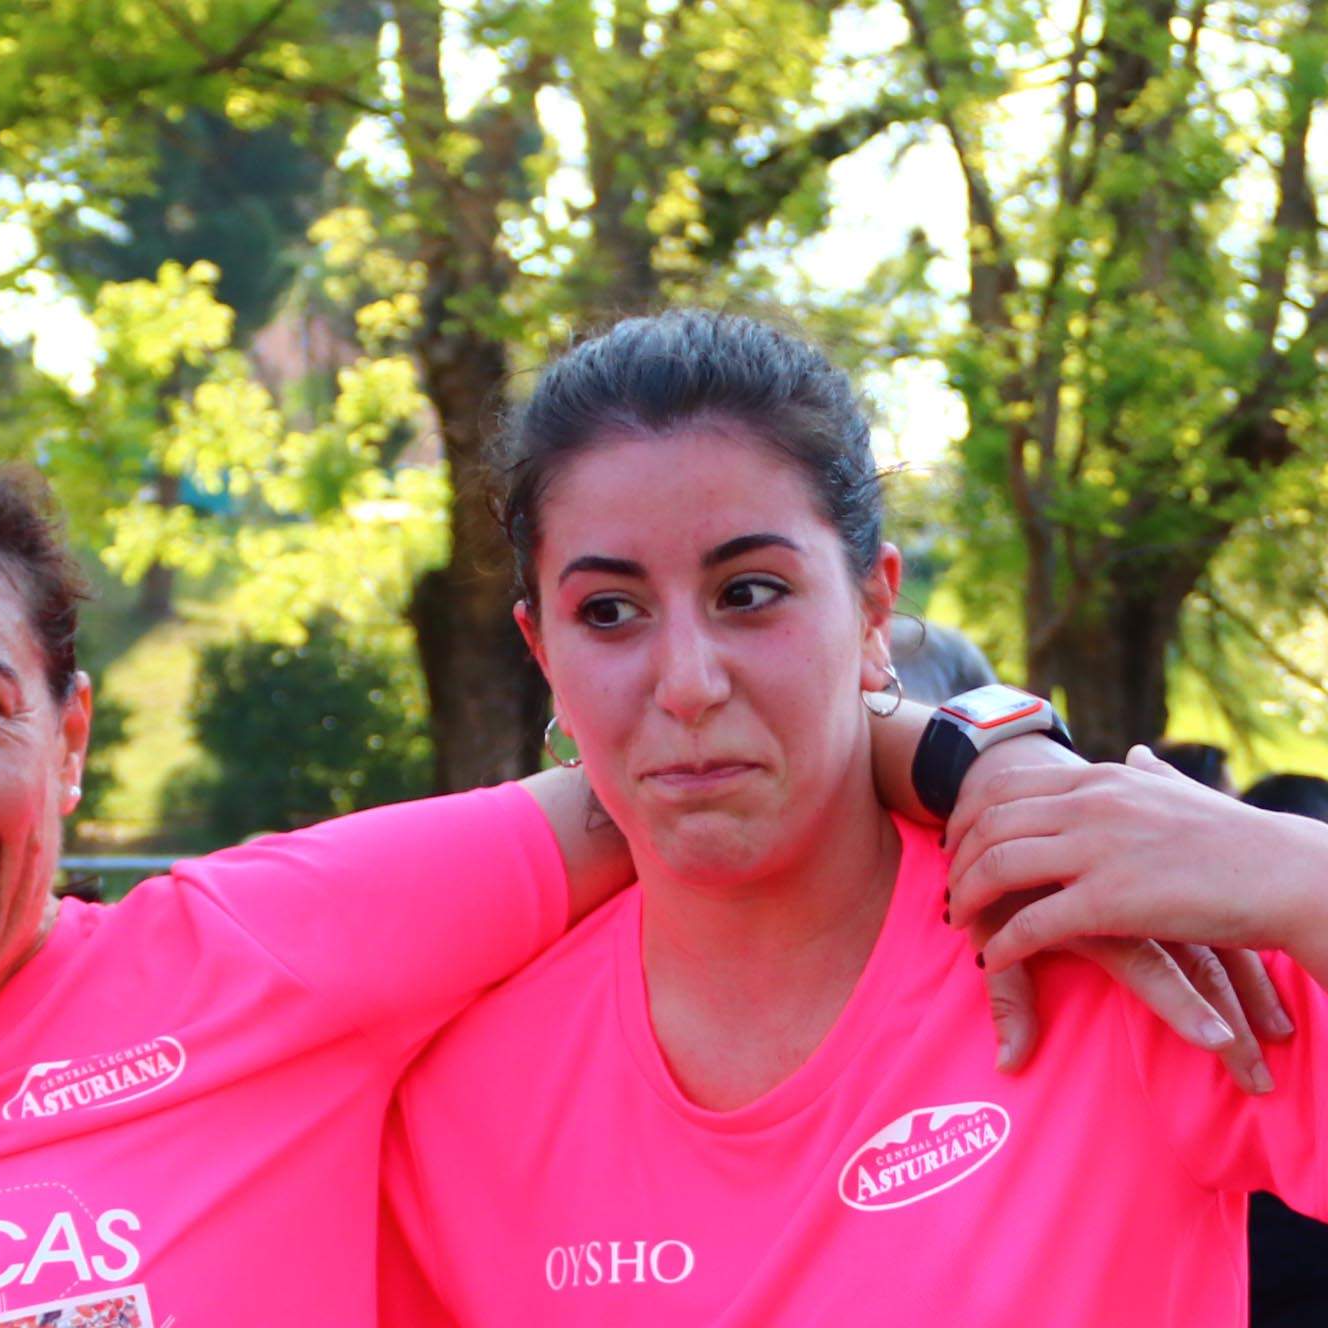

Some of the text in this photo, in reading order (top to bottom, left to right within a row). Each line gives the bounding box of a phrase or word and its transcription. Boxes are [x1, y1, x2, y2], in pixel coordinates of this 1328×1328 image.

[22, 1052, 176, 1120] ASTURIANA
[857, 1123, 999, 1202] ASTURIANA
[545, 1239, 695, 1291] OYSHO
